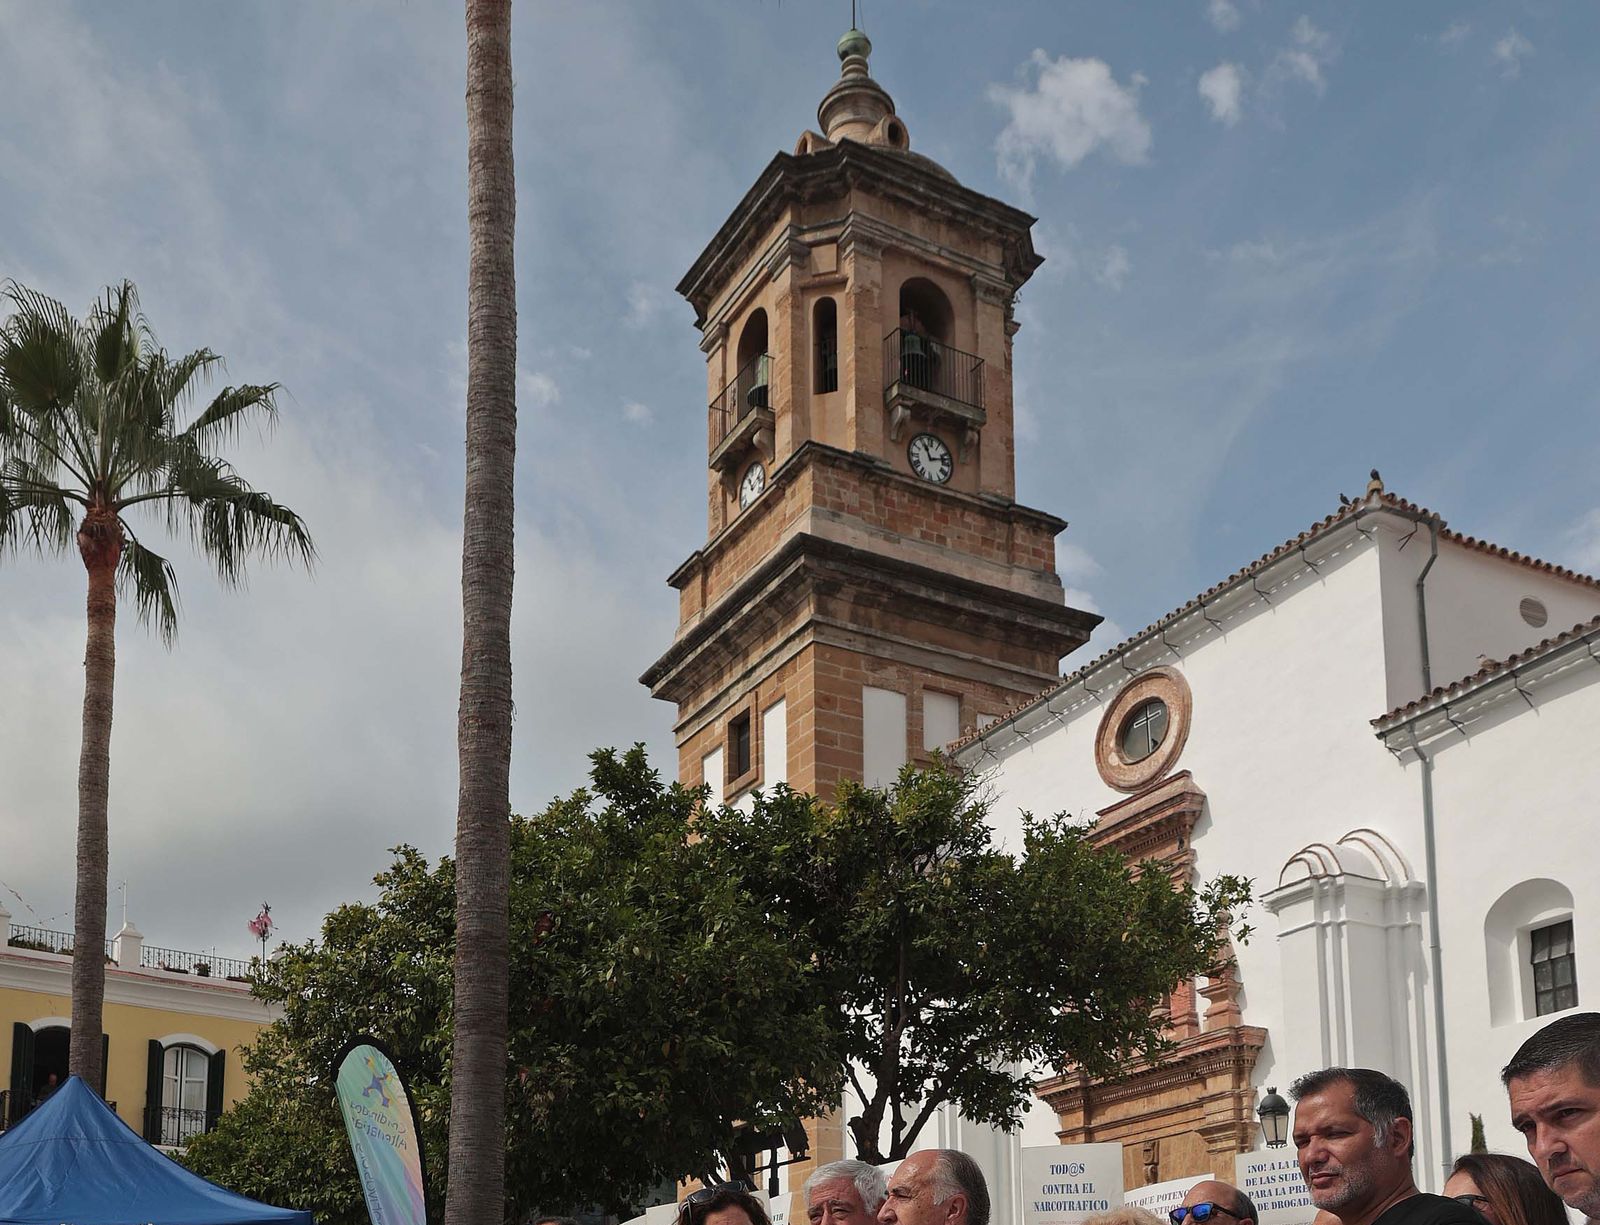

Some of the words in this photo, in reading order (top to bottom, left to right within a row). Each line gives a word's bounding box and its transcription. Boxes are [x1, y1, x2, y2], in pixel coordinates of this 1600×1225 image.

[1050, 1163, 1085, 1177] TOD@S
[1248, 1163, 1266, 1174] ¡NO!
[1270, 1162, 1276, 1171] A
[1278, 1161, 1290, 1170] LA
[1245, 1178, 1257, 1187] DE
[1260, 1175, 1276, 1185] LAS
[1042, 1183, 1079, 1195] CONTRA
[1082, 1182, 1095, 1194] EL
[1248, 1188, 1272, 1200] PARA
[1275, 1187, 1286, 1196] LA
[1034, 1199, 1108, 1212] NARCOTRAFICO
[1139, 1196, 1155, 1206] QUE
[1257, 1202, 1269, 1211] DE
